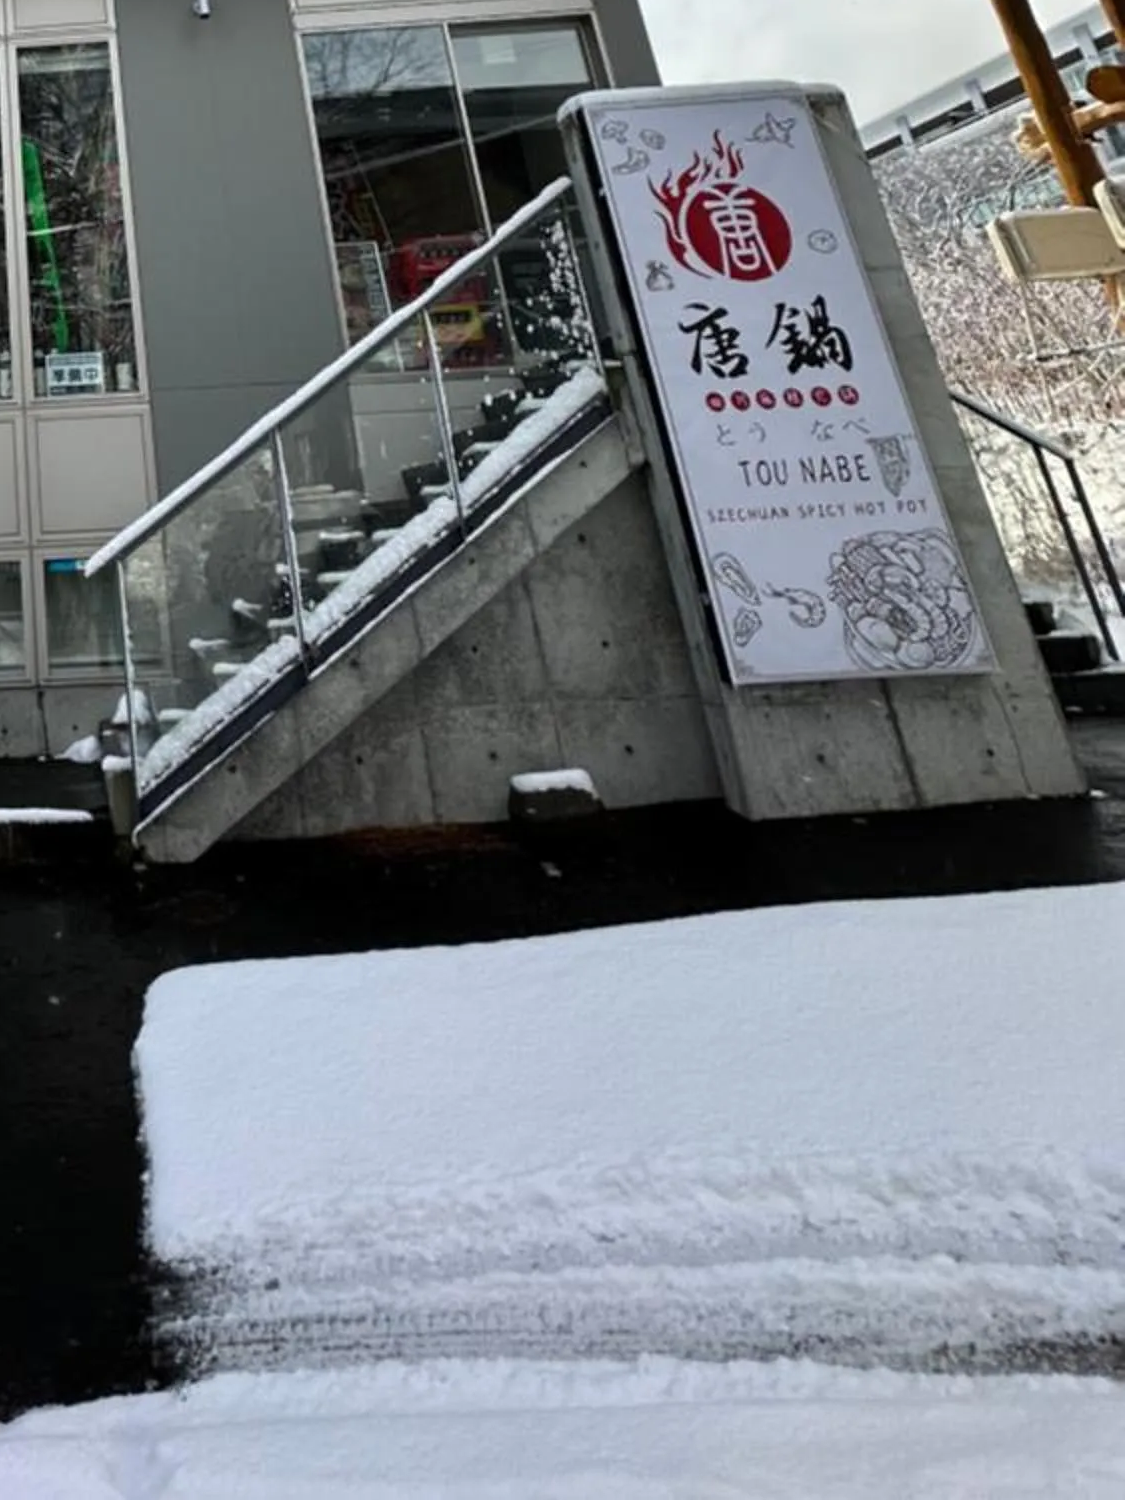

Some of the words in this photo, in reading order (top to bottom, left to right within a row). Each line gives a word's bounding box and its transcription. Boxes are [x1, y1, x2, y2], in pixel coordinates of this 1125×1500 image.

[678, 294, 853, 378] 唐鍋
[738, 459, 789, 488] TOU
[797, 453, 872, 485] NABE
[707, 505, 790, 524] SZECHUAN
[797, 501, 847, 520] SPICY
[853, 499, 887, 516] HOT
[895, 498, 927, 515] POT
